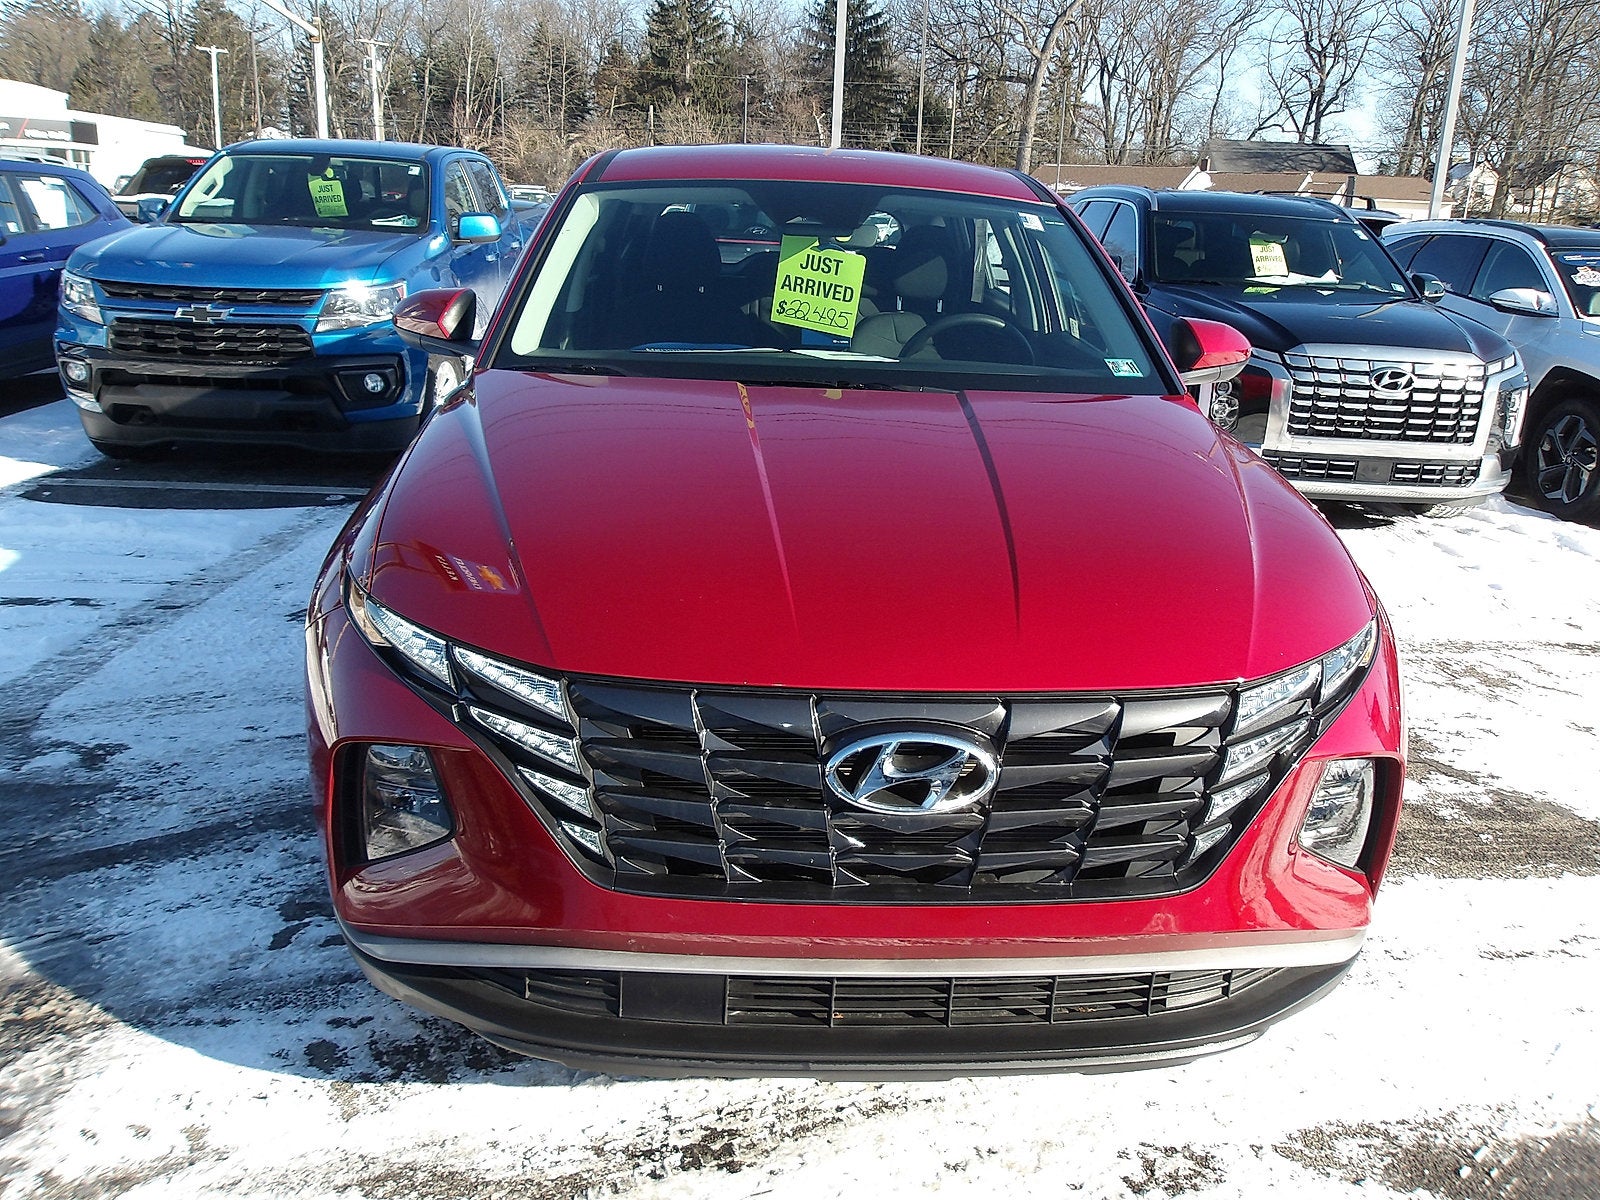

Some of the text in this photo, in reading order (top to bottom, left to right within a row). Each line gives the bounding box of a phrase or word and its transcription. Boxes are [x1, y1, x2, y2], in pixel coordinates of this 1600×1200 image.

[317, 184, 334, 193] JUST
[314, 194, 342, 204] ARRIVED
[1260, 245, 1275, 253] JUST
[799, 253, 844, 276] JUST
[780, 274, 855, 303] ARRIVED
[776, 299, 853, 329] $22,495
